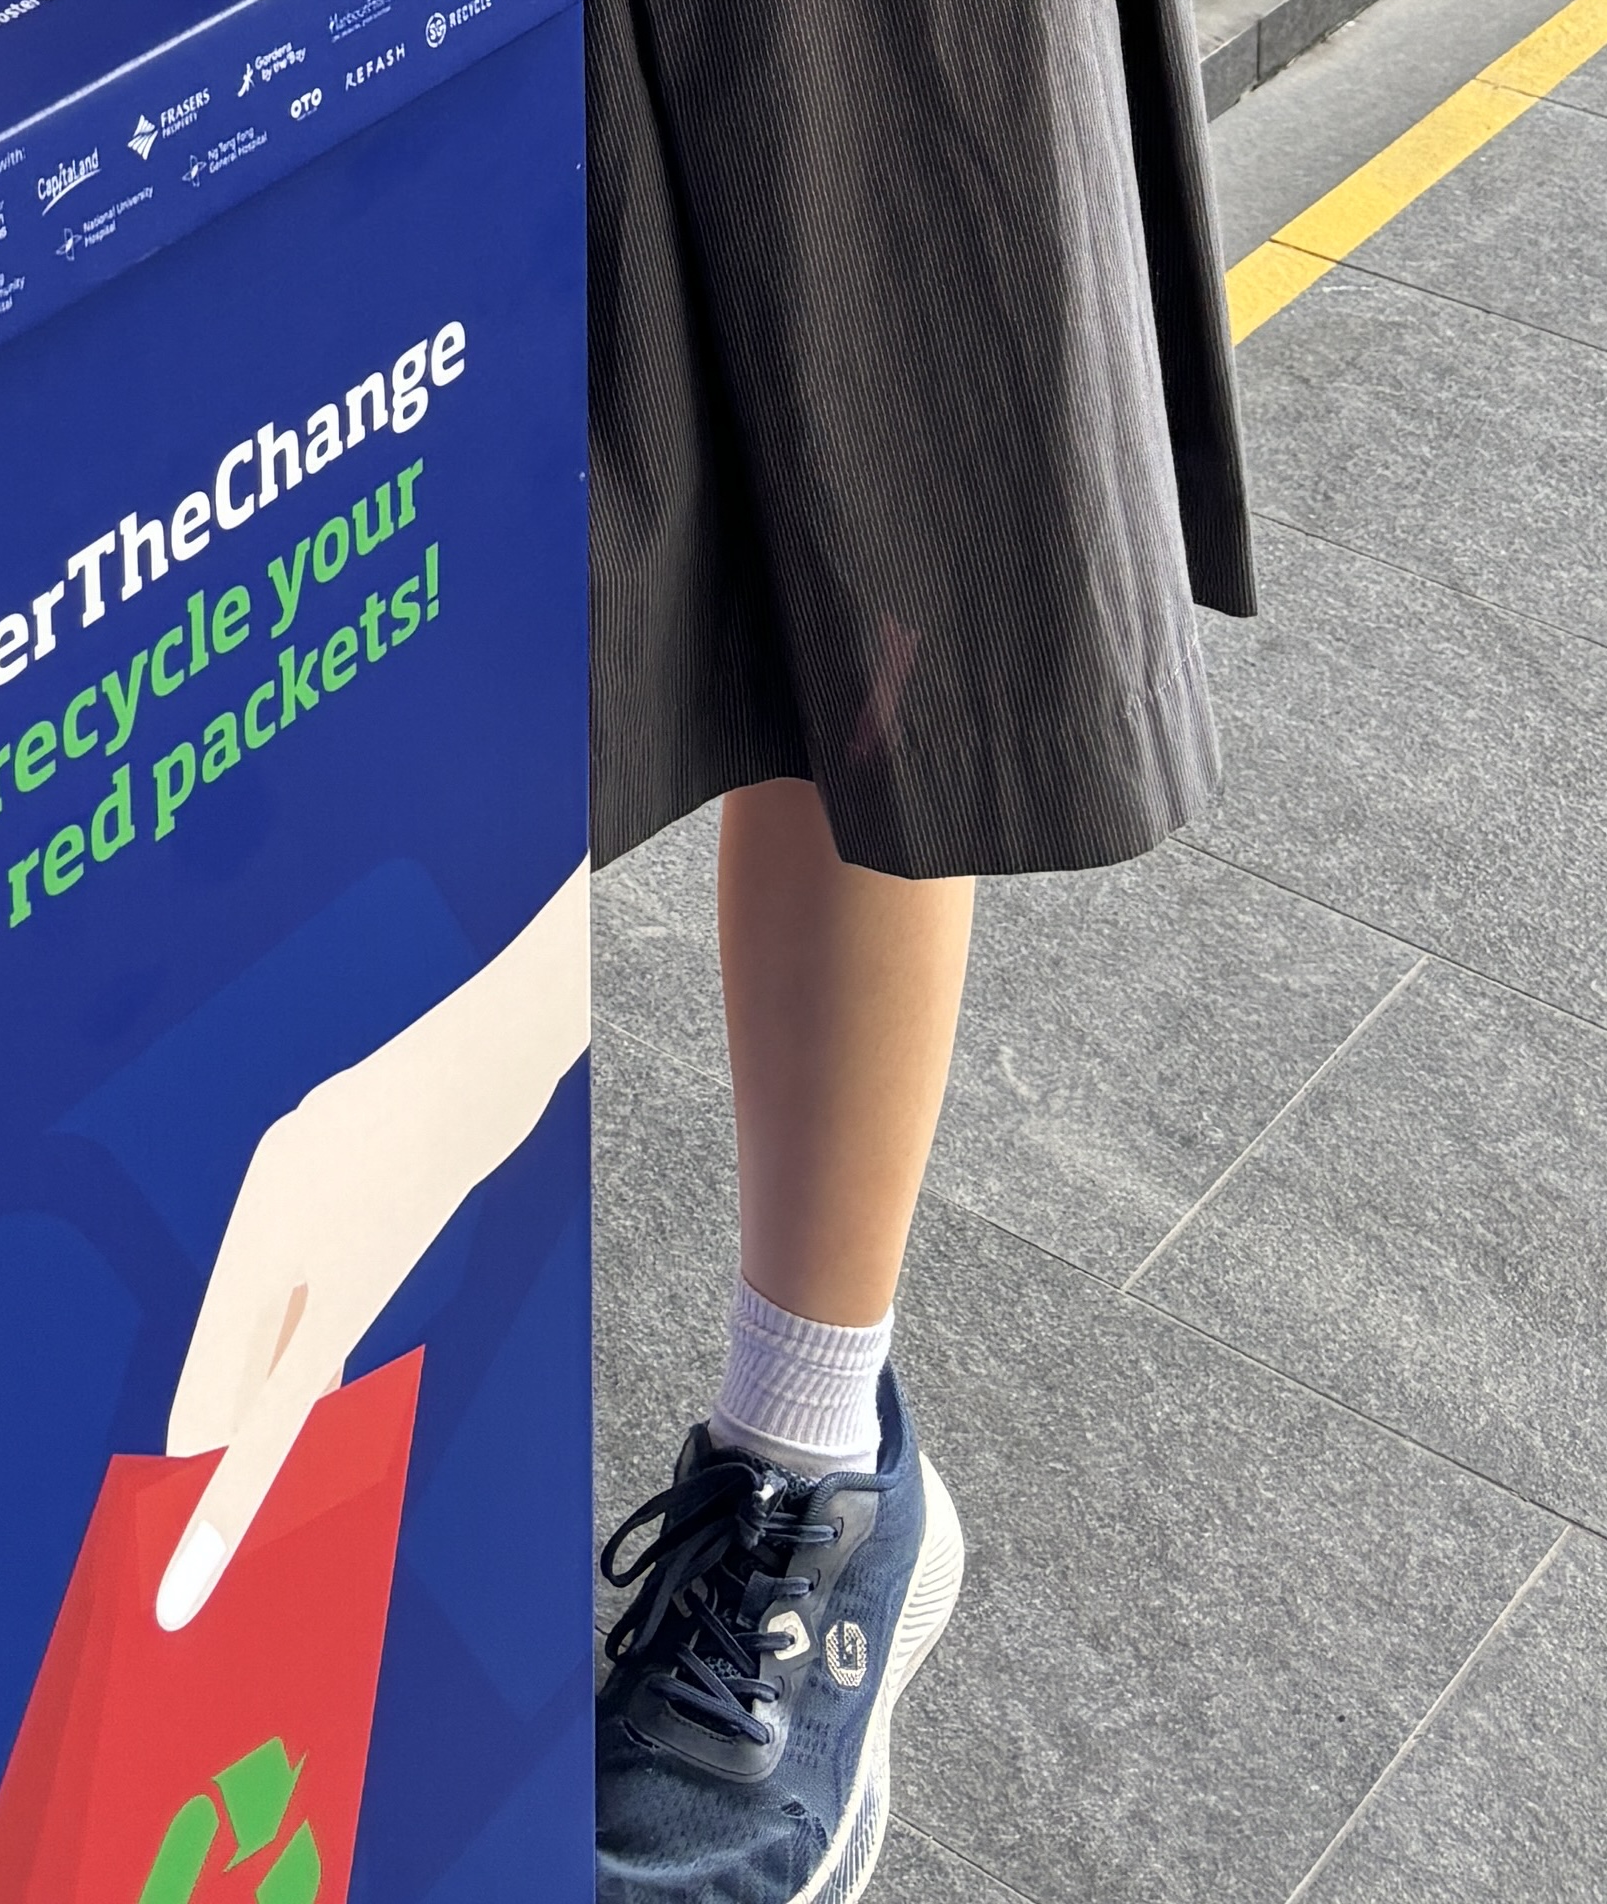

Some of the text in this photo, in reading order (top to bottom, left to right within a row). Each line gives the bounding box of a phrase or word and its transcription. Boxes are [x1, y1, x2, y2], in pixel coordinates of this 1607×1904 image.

[344, 44, 405, 91] REFASH
[160, 89, 210, 128] FRASERS
[290, 87, 322, 119] OTO
[37, 146, 100, 201] CapitaLand
[267, 457, 426, 640] your
[7, 764, 137, 929] red
[152, 542, 442, 841] packets!
